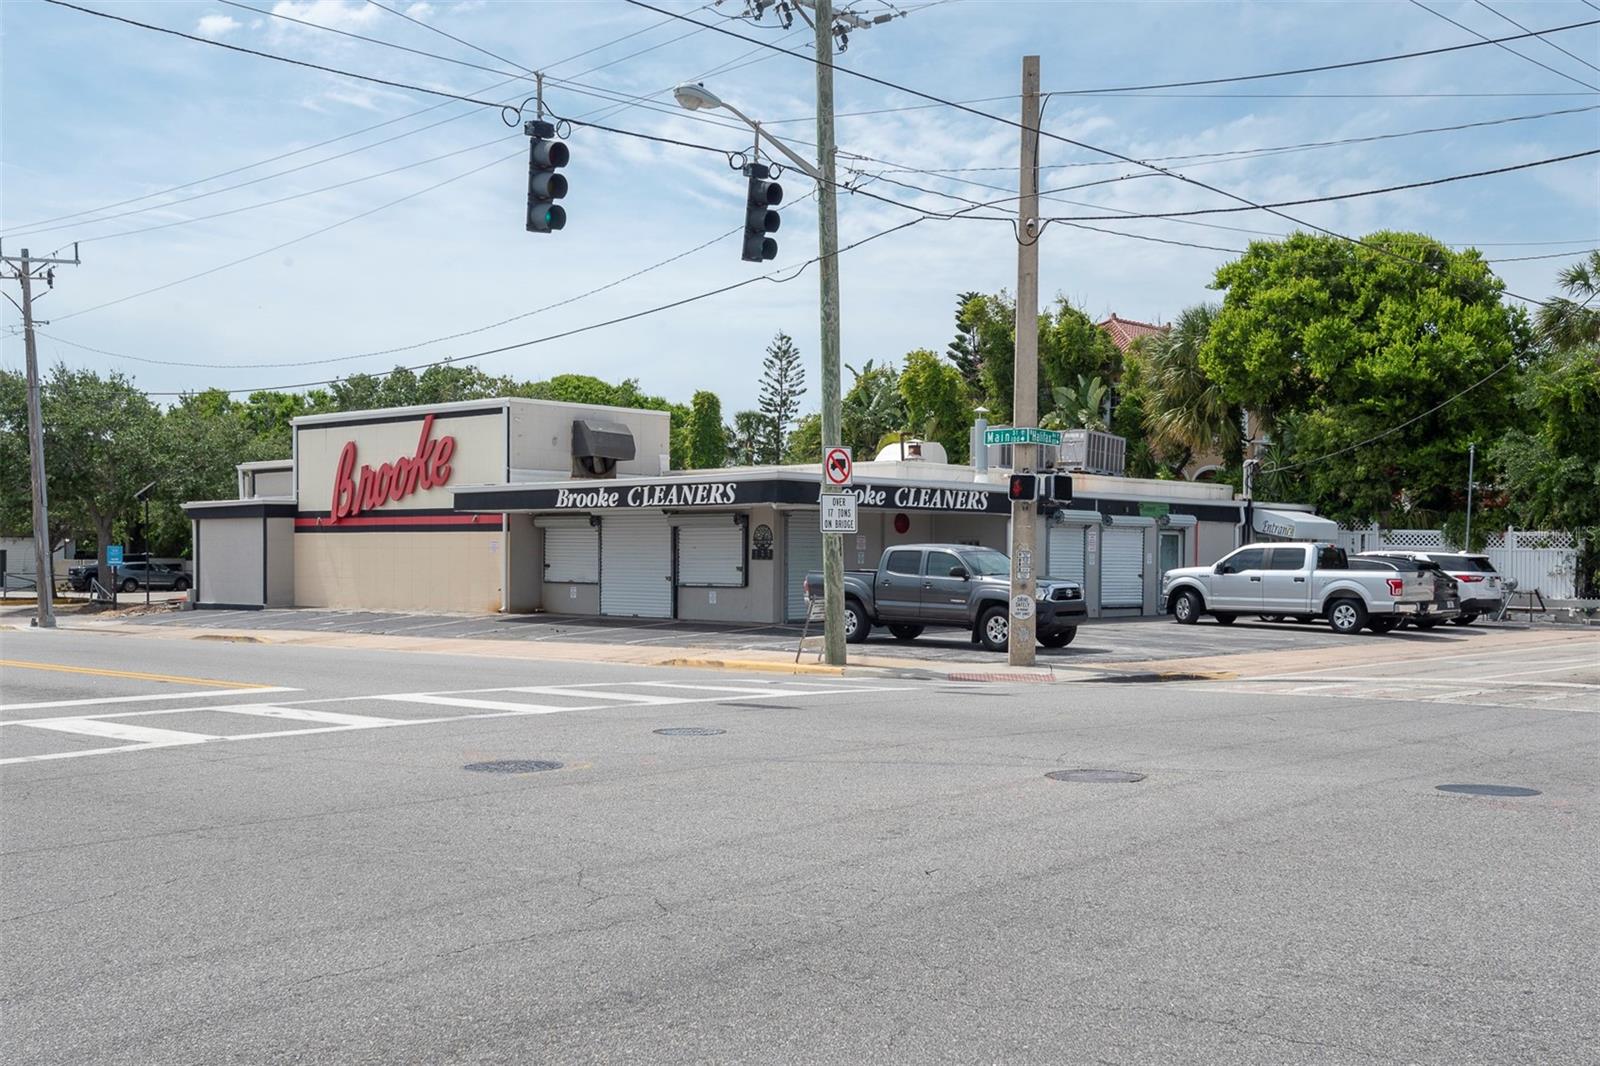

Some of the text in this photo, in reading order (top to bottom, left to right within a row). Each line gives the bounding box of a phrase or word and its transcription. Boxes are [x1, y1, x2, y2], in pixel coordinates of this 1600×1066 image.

[987, 431, 1010, 443] Main
[329, 412, 456, 524] Brooke
[555, 483, 737, 508] Brooke CLEANERS
[832, 497, 846, 506] OVER
[895, 487, 989, 511] CLEANERS
[828, 508, 851, 518] 17 TONS
[824, 519, 854, 529] ON BRIDGE
